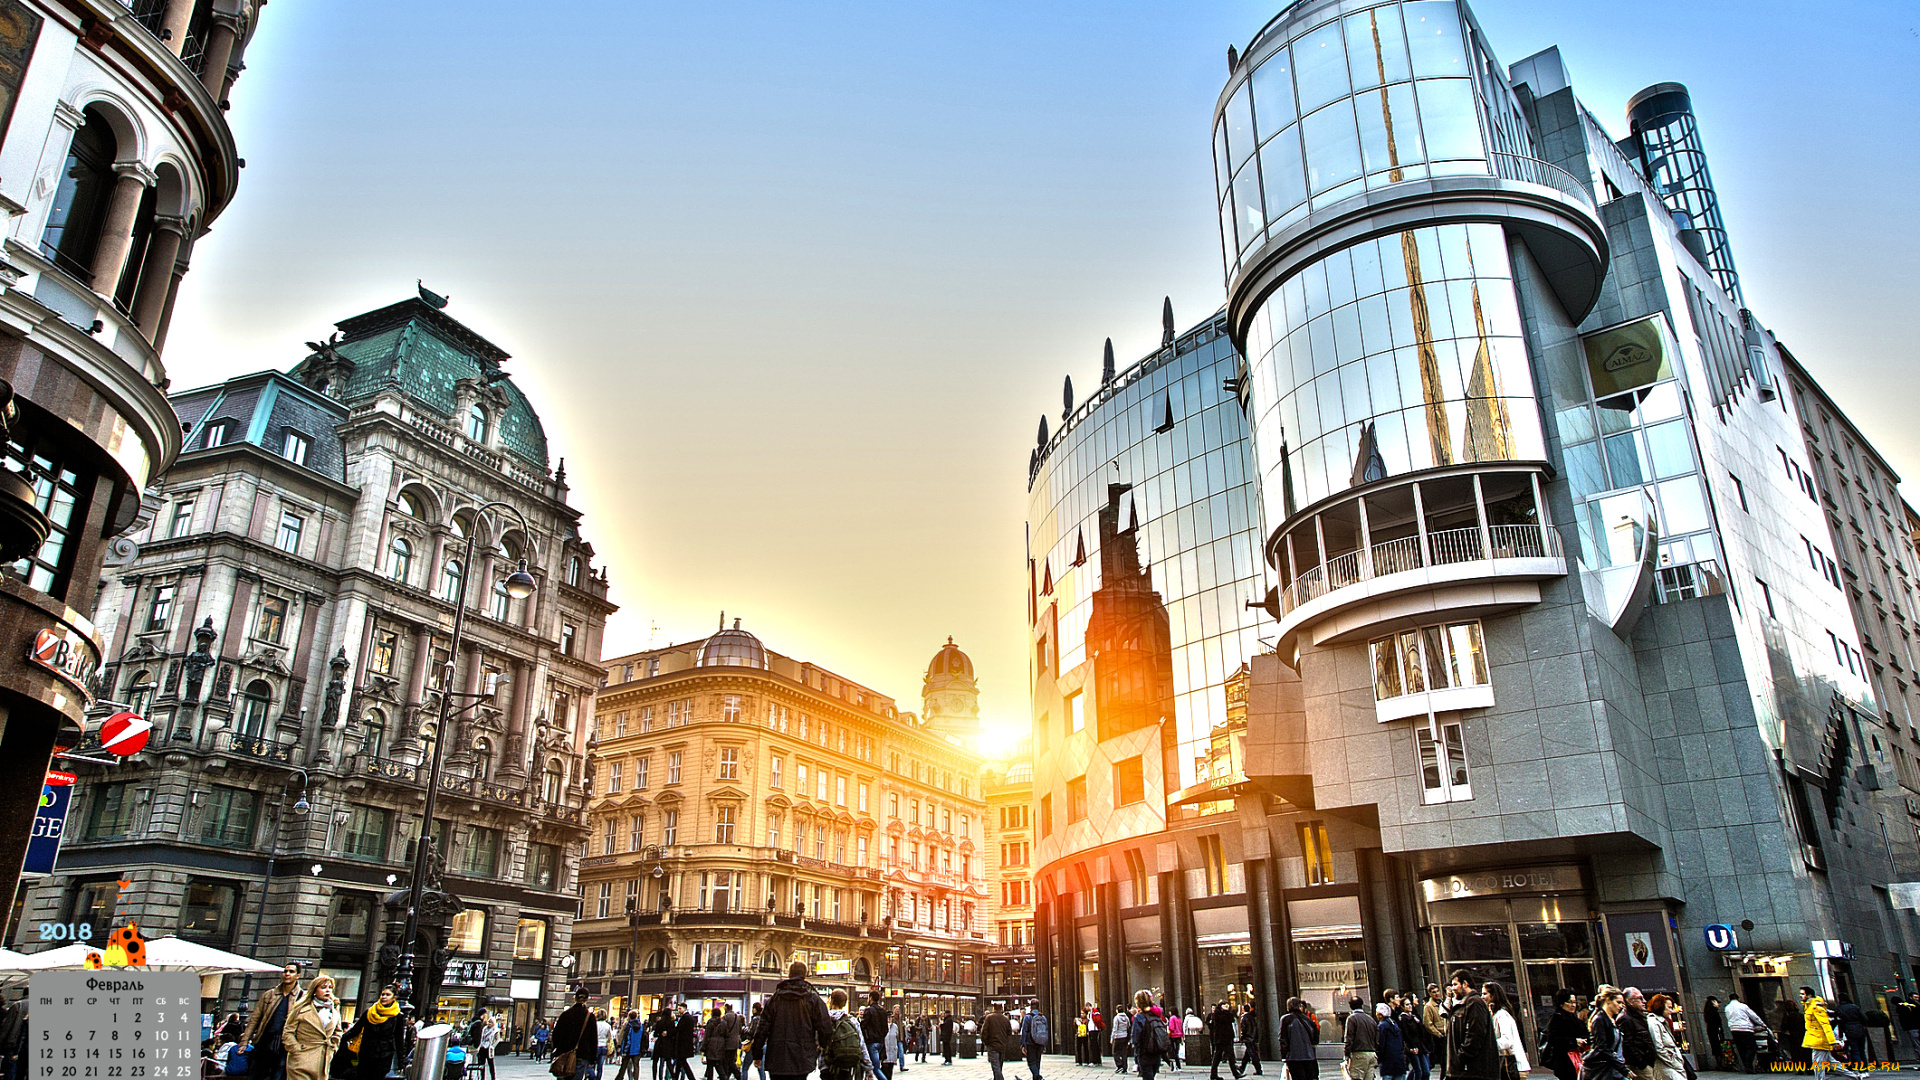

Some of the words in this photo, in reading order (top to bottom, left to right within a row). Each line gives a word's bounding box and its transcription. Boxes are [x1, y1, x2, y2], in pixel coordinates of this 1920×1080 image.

[1611, 351, 1646, 367] ALMAZ
[55, 639, 88, 682] Bank
[1502, 872, 1558, 889] HOTEL
[1707, 929, 1730, 948] U
